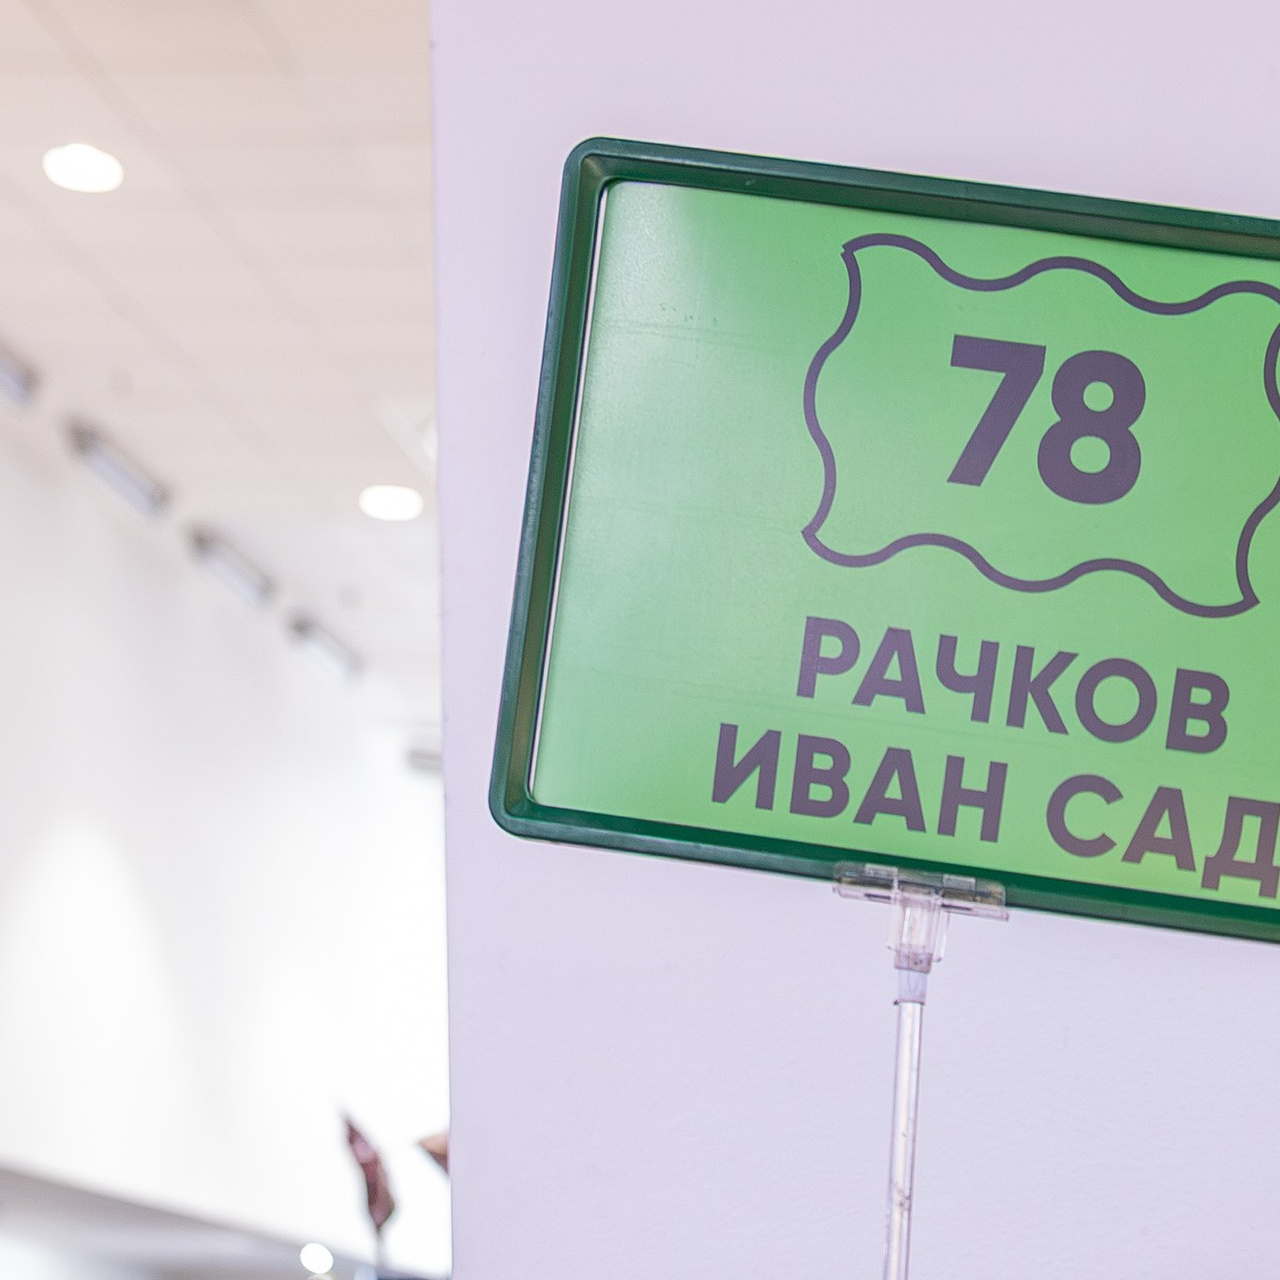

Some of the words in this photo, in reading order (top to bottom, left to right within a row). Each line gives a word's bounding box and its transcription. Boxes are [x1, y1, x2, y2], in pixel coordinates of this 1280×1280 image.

[946, 333, 1147, 504] 78
[796, 615, 1231, 755] РАЧКОВ
[710, 721, 1009, 843] ИВАН
